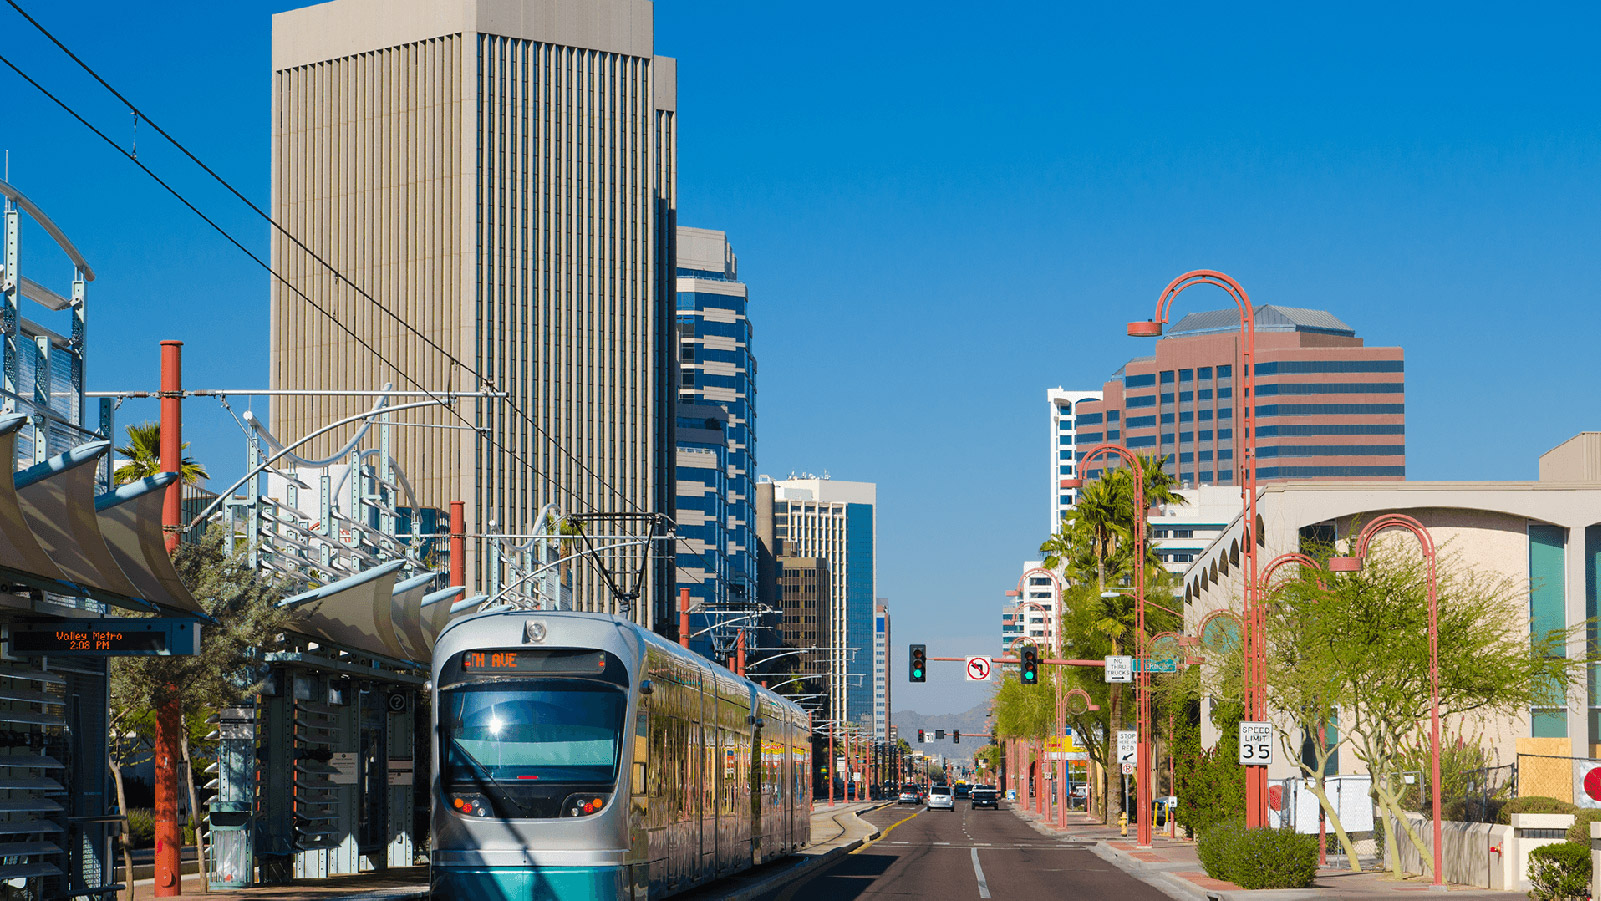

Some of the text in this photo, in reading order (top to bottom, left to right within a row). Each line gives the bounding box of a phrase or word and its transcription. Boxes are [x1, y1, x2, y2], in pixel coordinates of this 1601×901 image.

[56, 631, 123, 640] Valley Metro
[69, 641, 110, 650] 2:08 PM
[491, 653, 517, 667] AVE
[1242, 744, 1270, 759] 35
